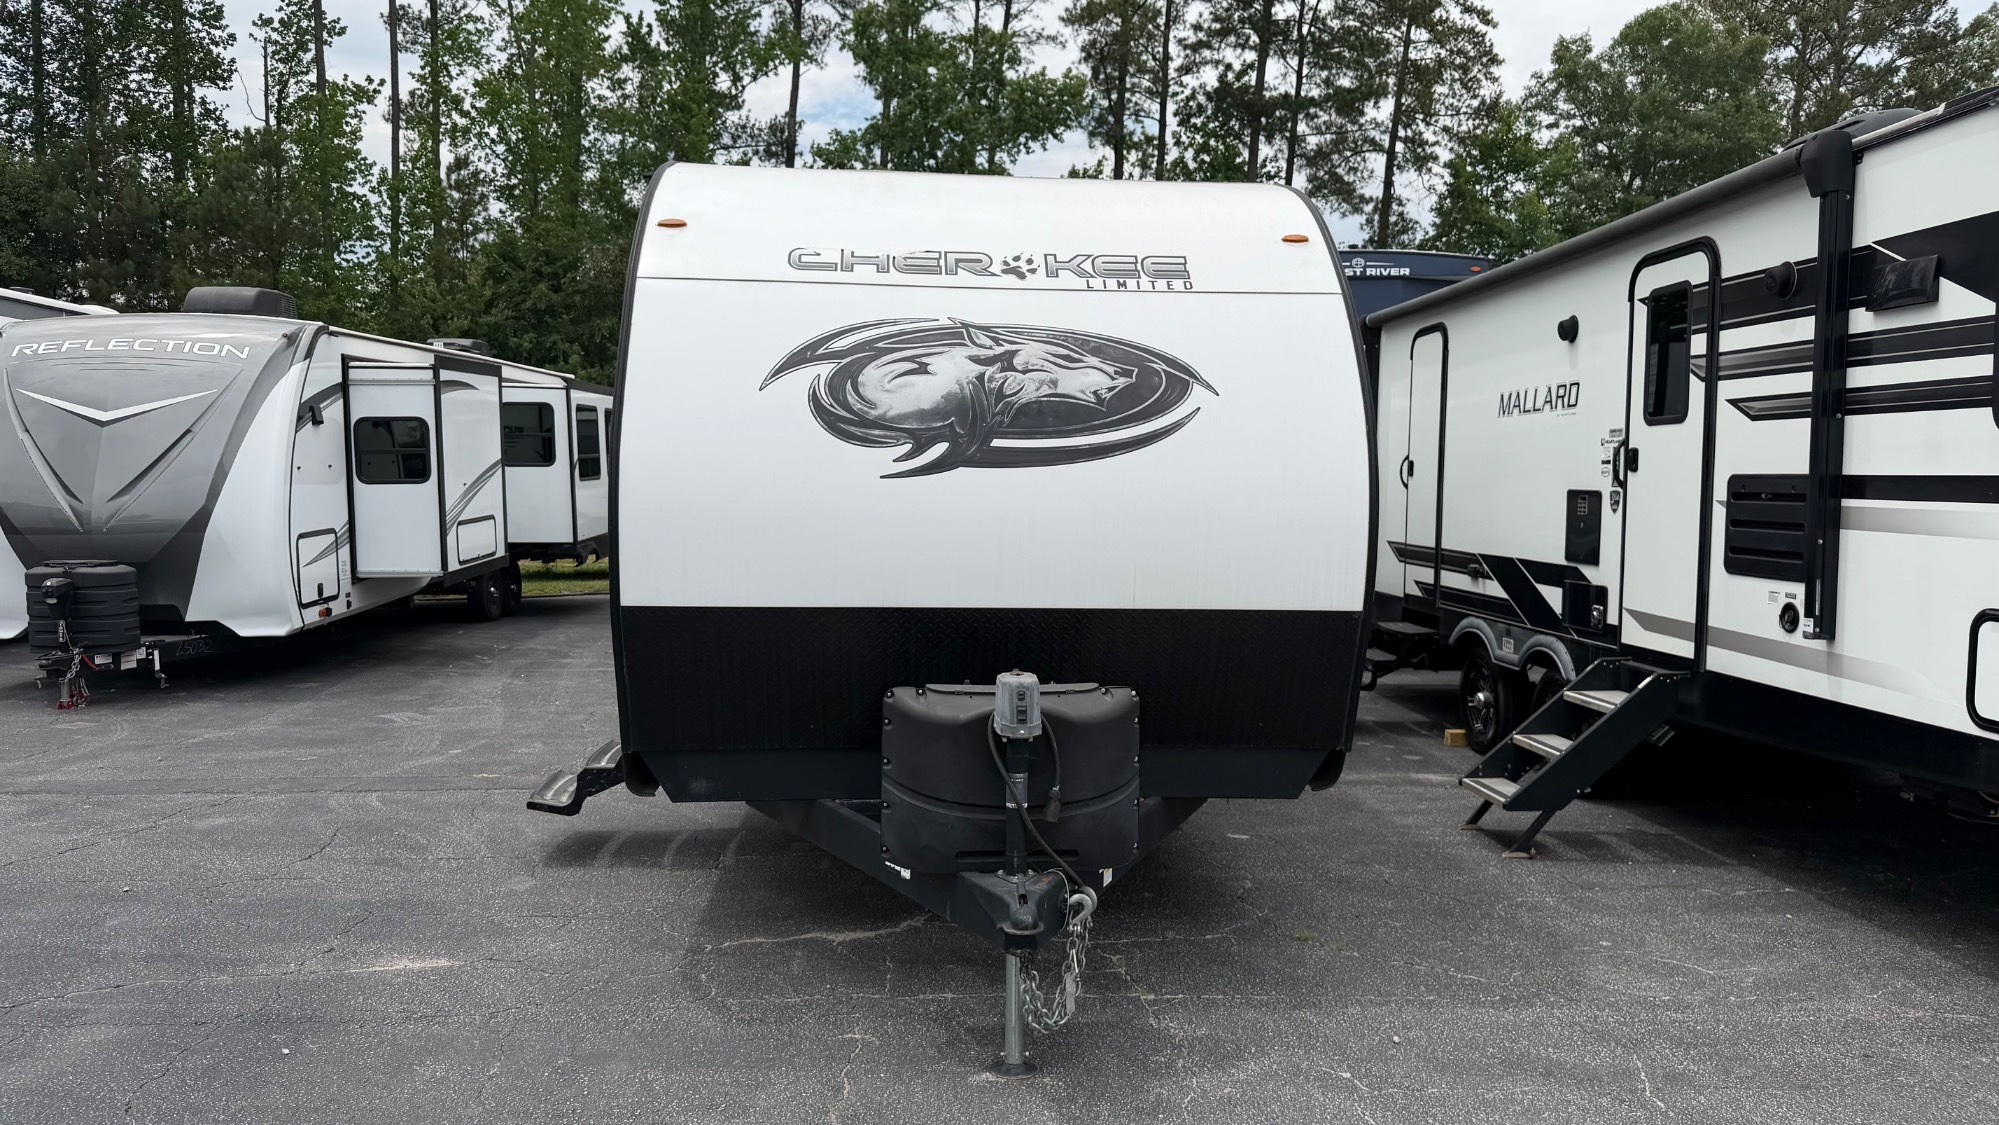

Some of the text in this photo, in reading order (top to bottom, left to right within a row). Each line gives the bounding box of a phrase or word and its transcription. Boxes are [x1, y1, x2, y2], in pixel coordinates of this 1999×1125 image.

[1344, 267, 1411, 276] ST RIVER
[1085, 279, 1194, 291] LIMITED
[10, 337, 252, 360] REFLECTION
[1496, 380, 1581, 418] MALLARD
[175, 640, 214, 656] 25032
